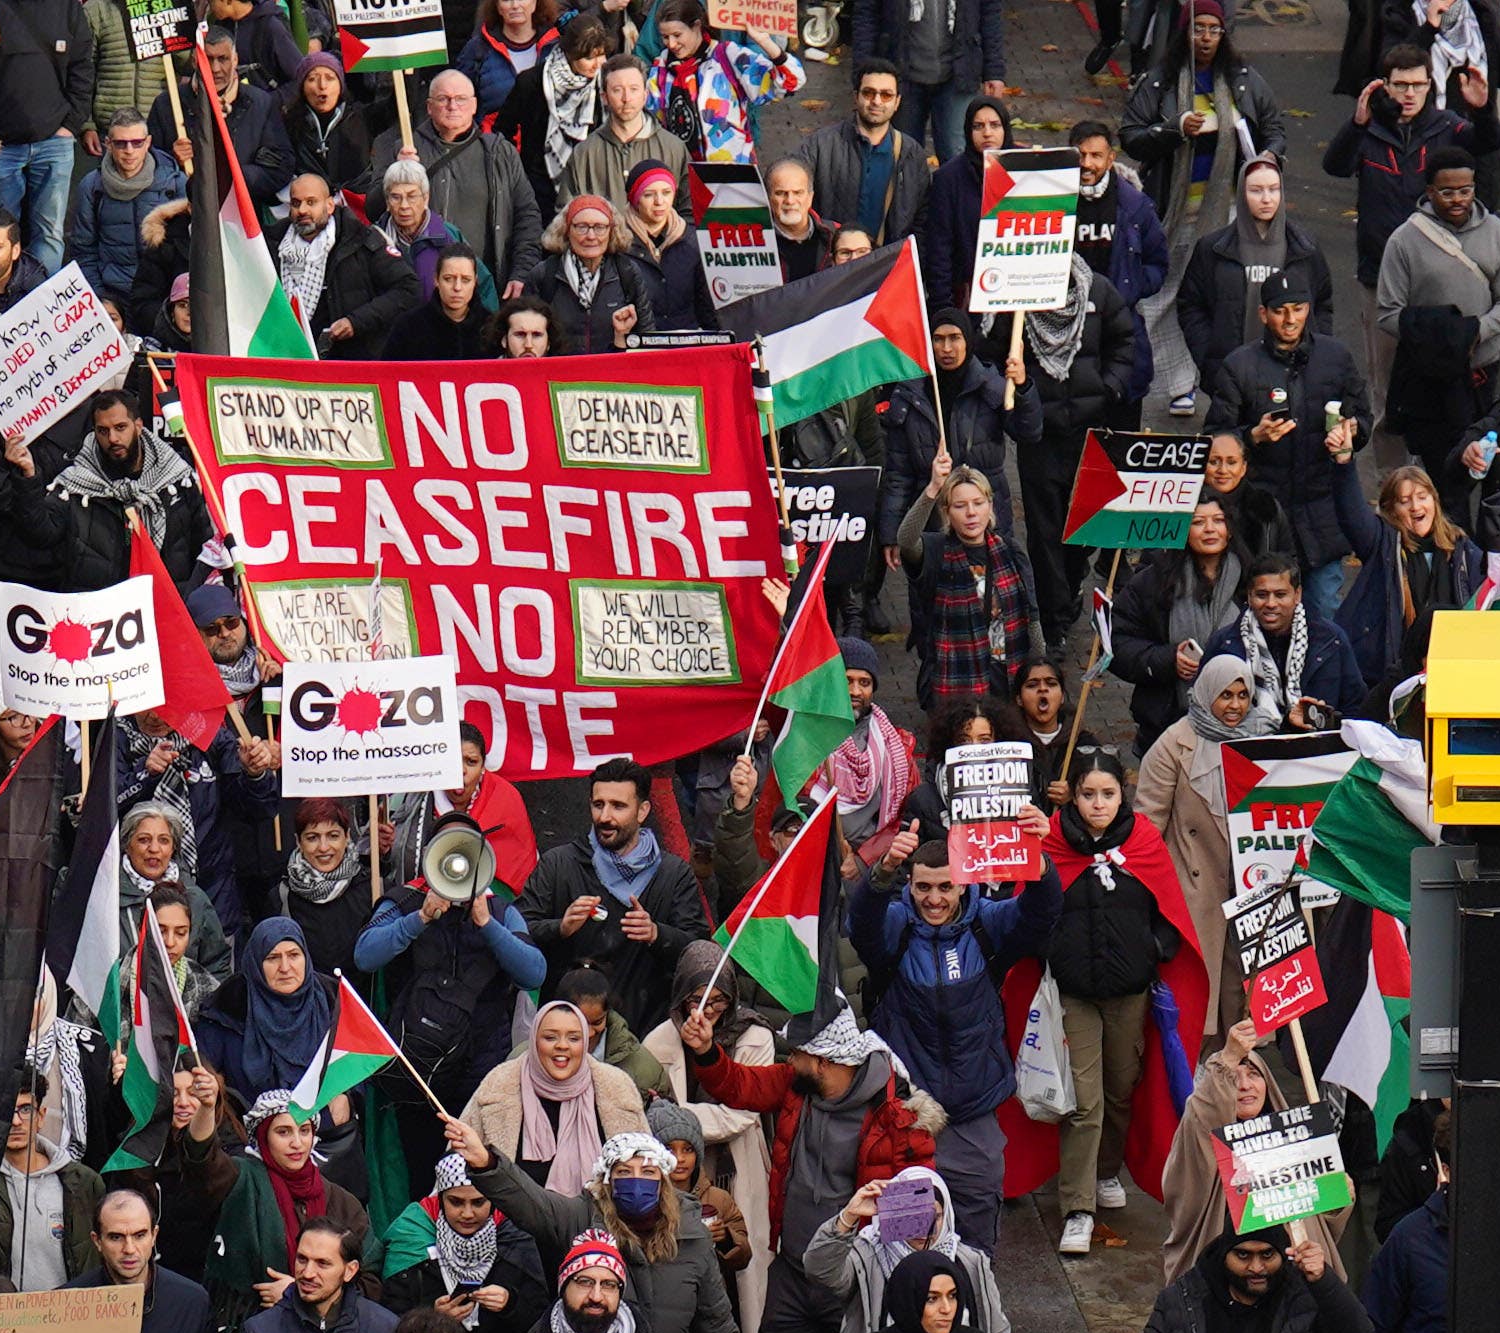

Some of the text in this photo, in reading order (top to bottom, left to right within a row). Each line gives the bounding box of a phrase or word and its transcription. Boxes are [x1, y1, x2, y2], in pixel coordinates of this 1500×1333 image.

[995, 210, 1066, 237] FREE
[982, 238, 1069, 258] PALESTINE
[3, 310, 41, 351] know
[47, 278, 83, 318] what
[3, 341, 35, 377] DIED
[37, 329, 54, 349] in
[53, 292, 95, 334] GAZA?
[219, 390, 372, 424] STAND UP FOR
[577, 397, 685, 426] DEMAND A
[245, 426, 350, 454] HUMANITY
[403, 382, 528, 470] NO
[569, 429, 694, 459] CEASEFIRE
[1126, 441, 1206, 470] CEASE
[1129, 479, 1196, 505] FIRE
[225, 475, 767, 578] CEASEFIRE
[1128, 517, 1181, 540] NOW
[604, 594, 689, 618] WE WILL
[6, 604, 146, 657] Gza
[433, 584, 555, 676] NO
[602, 622, 710, 645] REMEMBER
[590, 647, 726, 673] YOUR CHOICE
[289, 680, 445, 728] Gza
[461, 688, 634, 771] OTE
[291, 741, 447, 762] Stop the massacre
[954, 762, 1028, 787] FREEDOM
